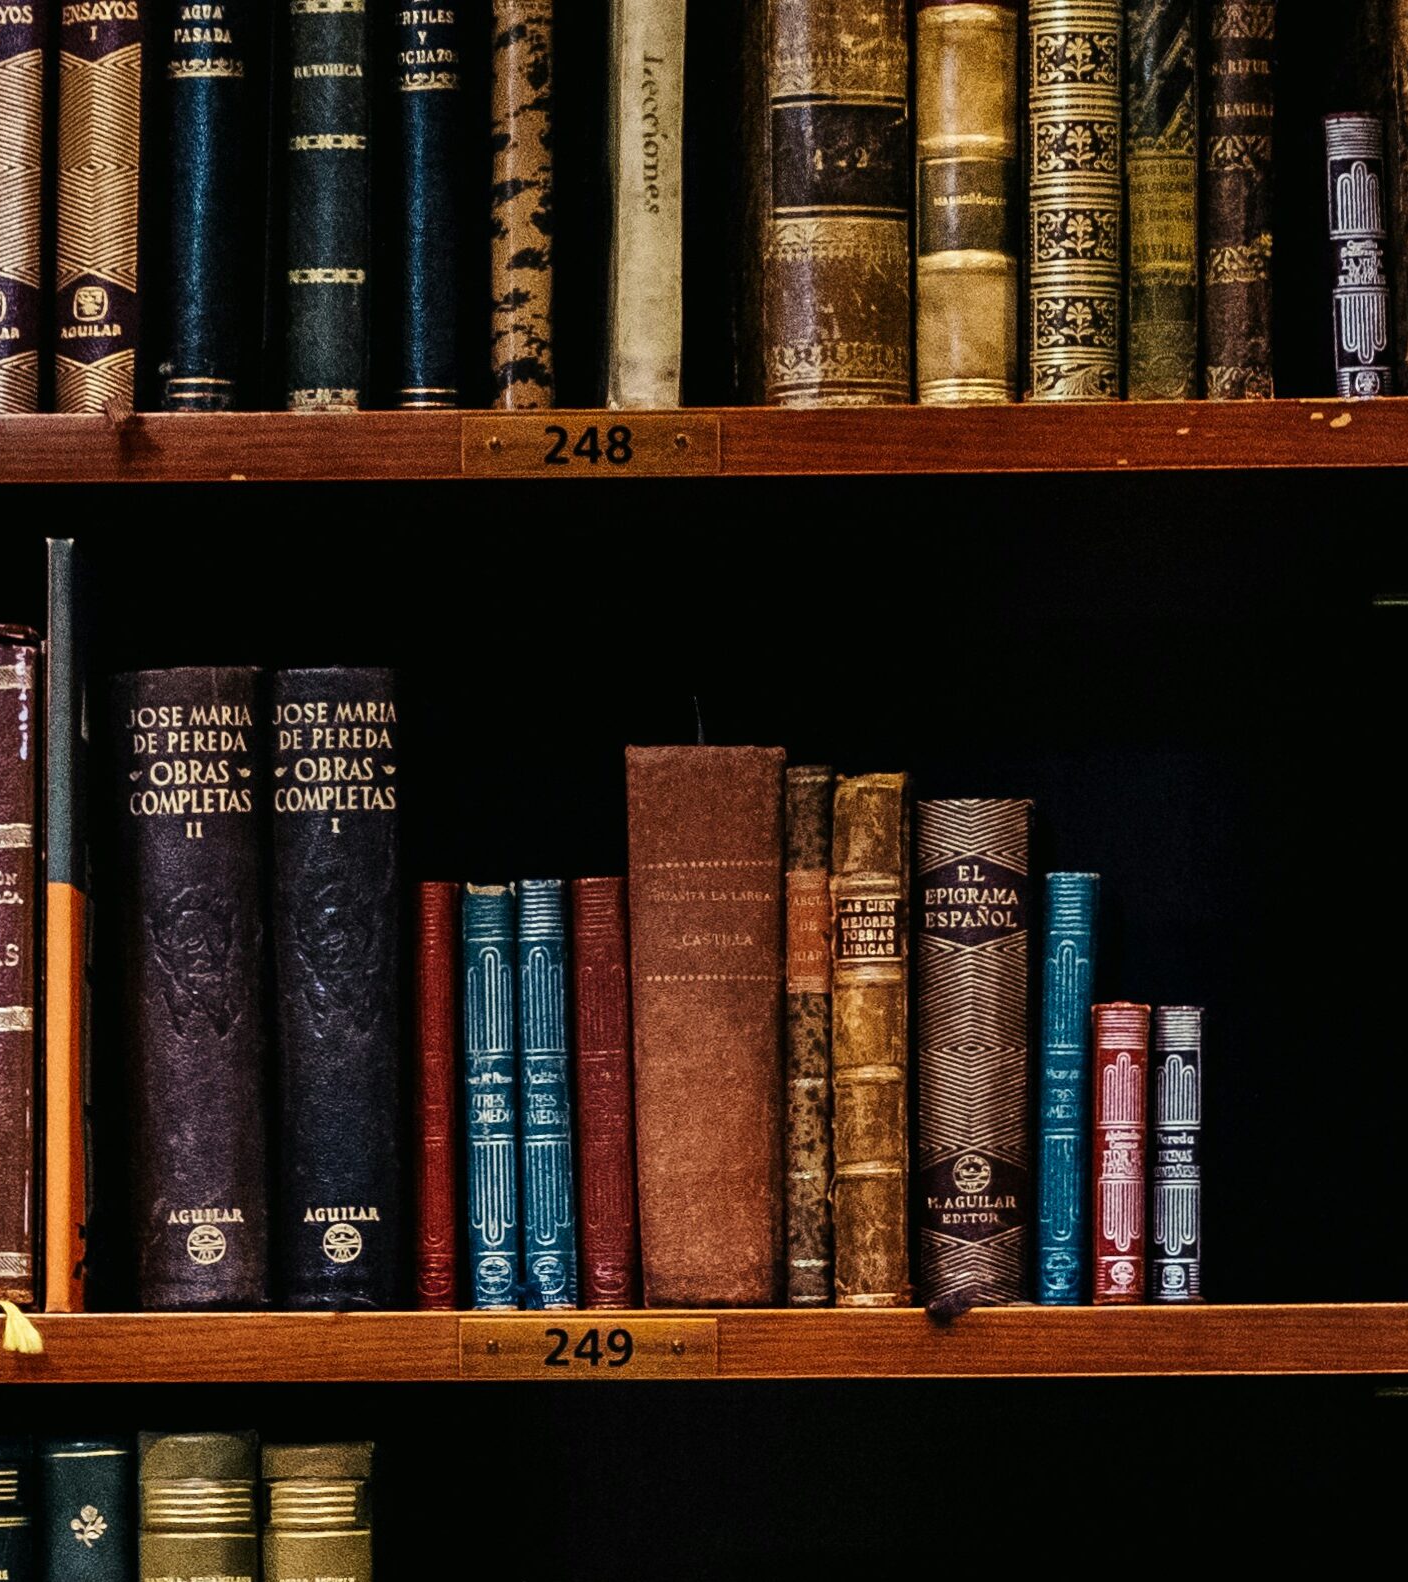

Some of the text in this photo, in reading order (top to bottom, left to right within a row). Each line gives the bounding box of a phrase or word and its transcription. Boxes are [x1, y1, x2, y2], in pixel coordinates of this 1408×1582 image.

[61, 2, 139, 23] ENSAYOS
[417, 30, 427, 45] Y
[61, 323, 121, 339] AGUILAR
[544, 426, 633, 464] 248
[126, 704, 253, 729] JOSE MARIA
[272, 701, 397, 725] JOSE MARIA
[133, 730, 247, 754] DE PEREDA
[278, 727, 393, 750] DE PEREDA
[149, 759, 230, 786] OBRAS
[294, 757, 374, 783] OBRAS
[129, 788, 253, 815] COMPLETAS
[274, 785, 397, 813] COMPLETAS
[185, 821, 204, 839] II
[957, 865, 986, 883] EL
[924, 887, 1018, 905] EPIGRAMA
[924, 906, 1018, 929] ESPAÑOL
[167, 1207, 245, 1223] AGUILAR
[304, 1206, 380, 1222] AGUILAR
[544, 1328, 634, 1367] 249
